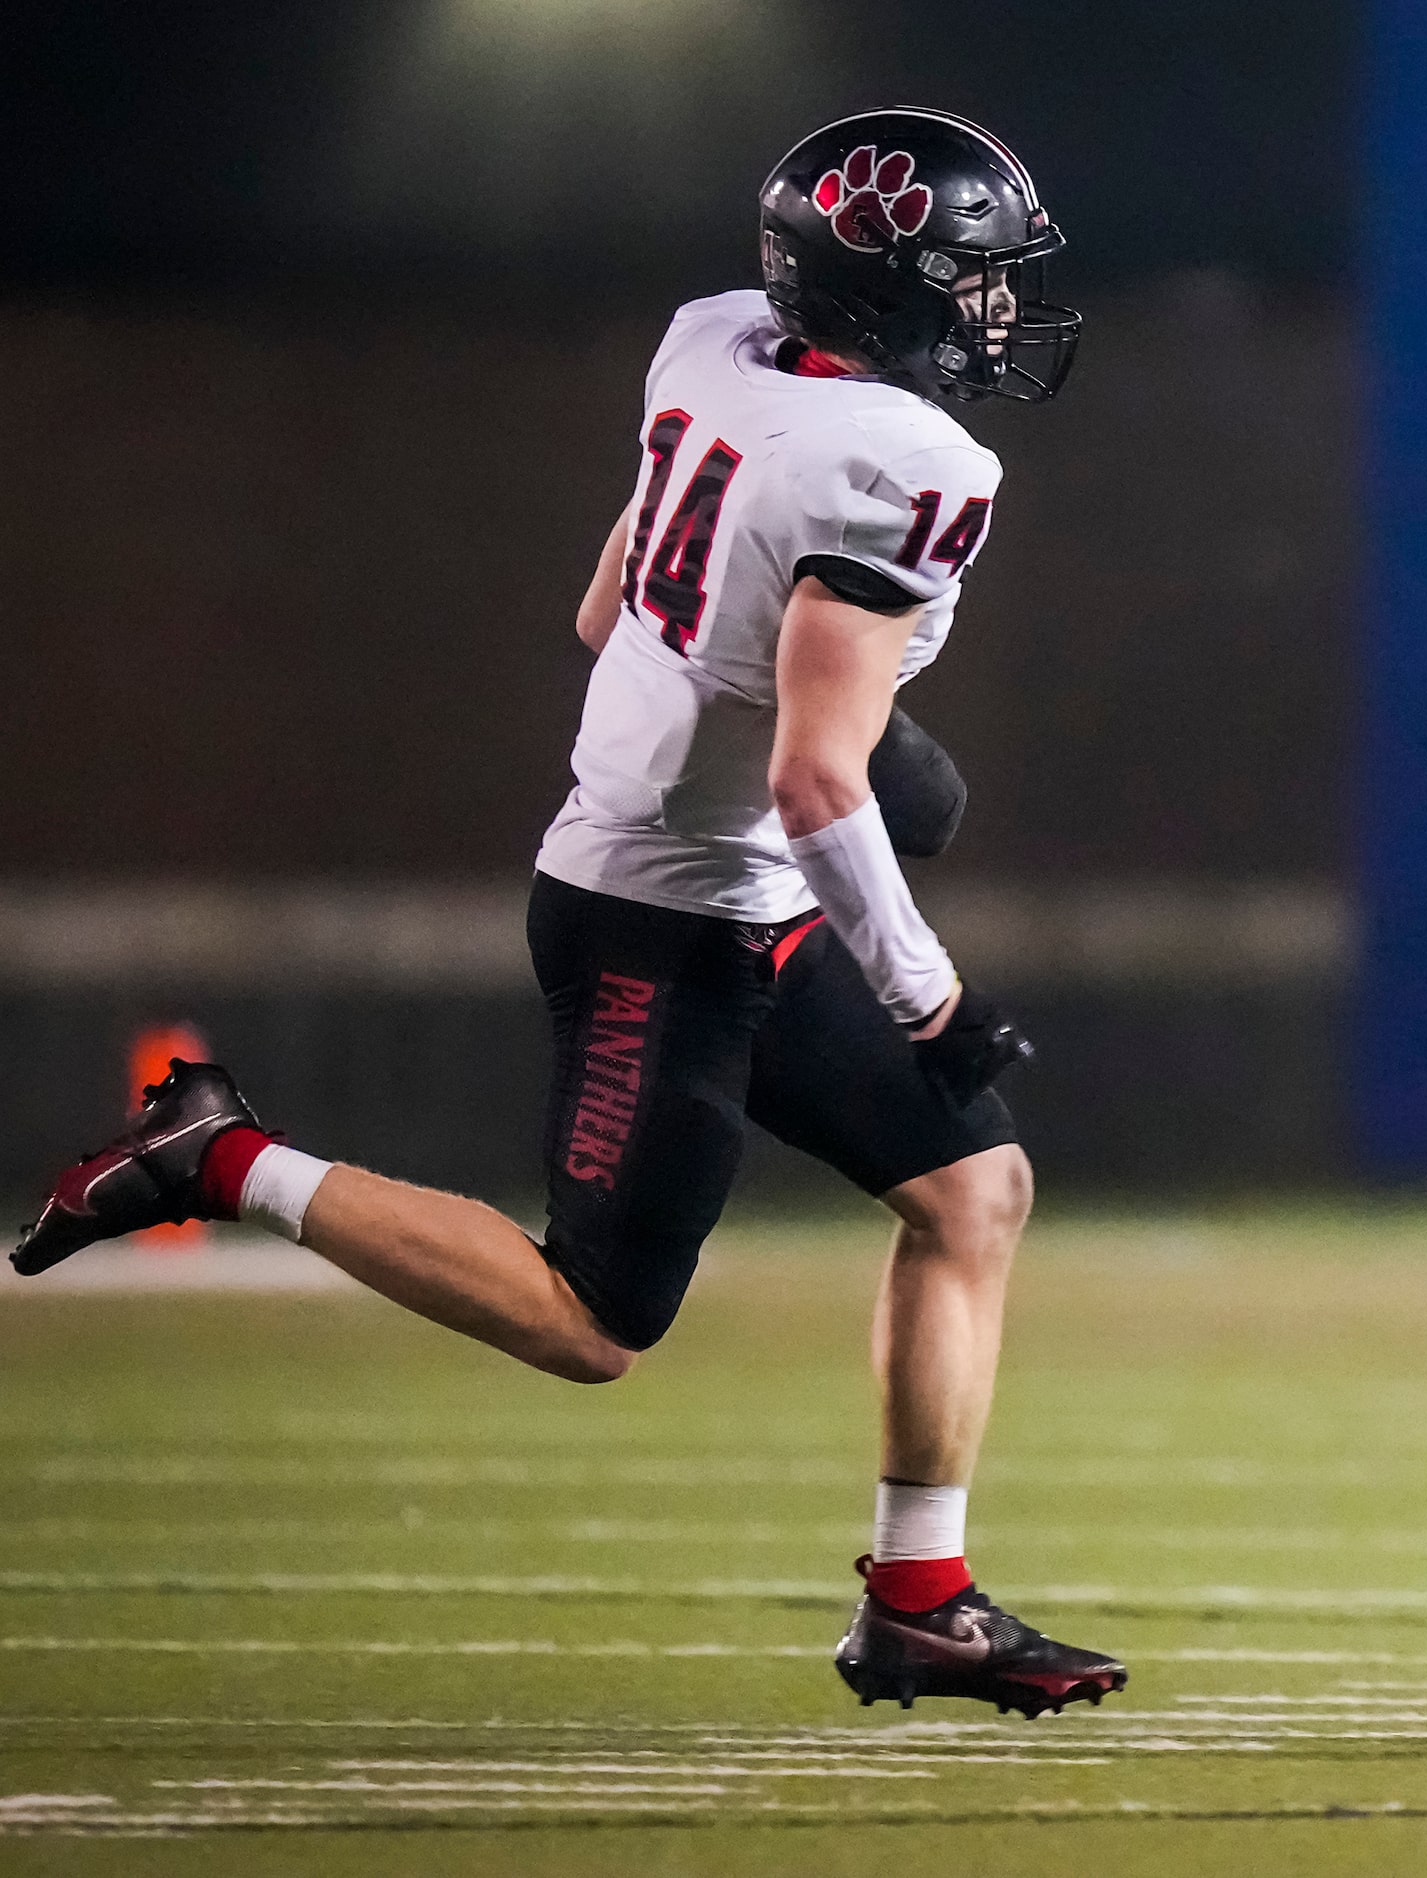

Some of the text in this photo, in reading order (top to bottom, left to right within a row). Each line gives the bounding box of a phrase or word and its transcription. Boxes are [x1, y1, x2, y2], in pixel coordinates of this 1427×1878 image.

[622, 408, 743, 659] 14
[894, 489, 993, 577] 14
[565, 971, 656, 1191] PANTHERS
